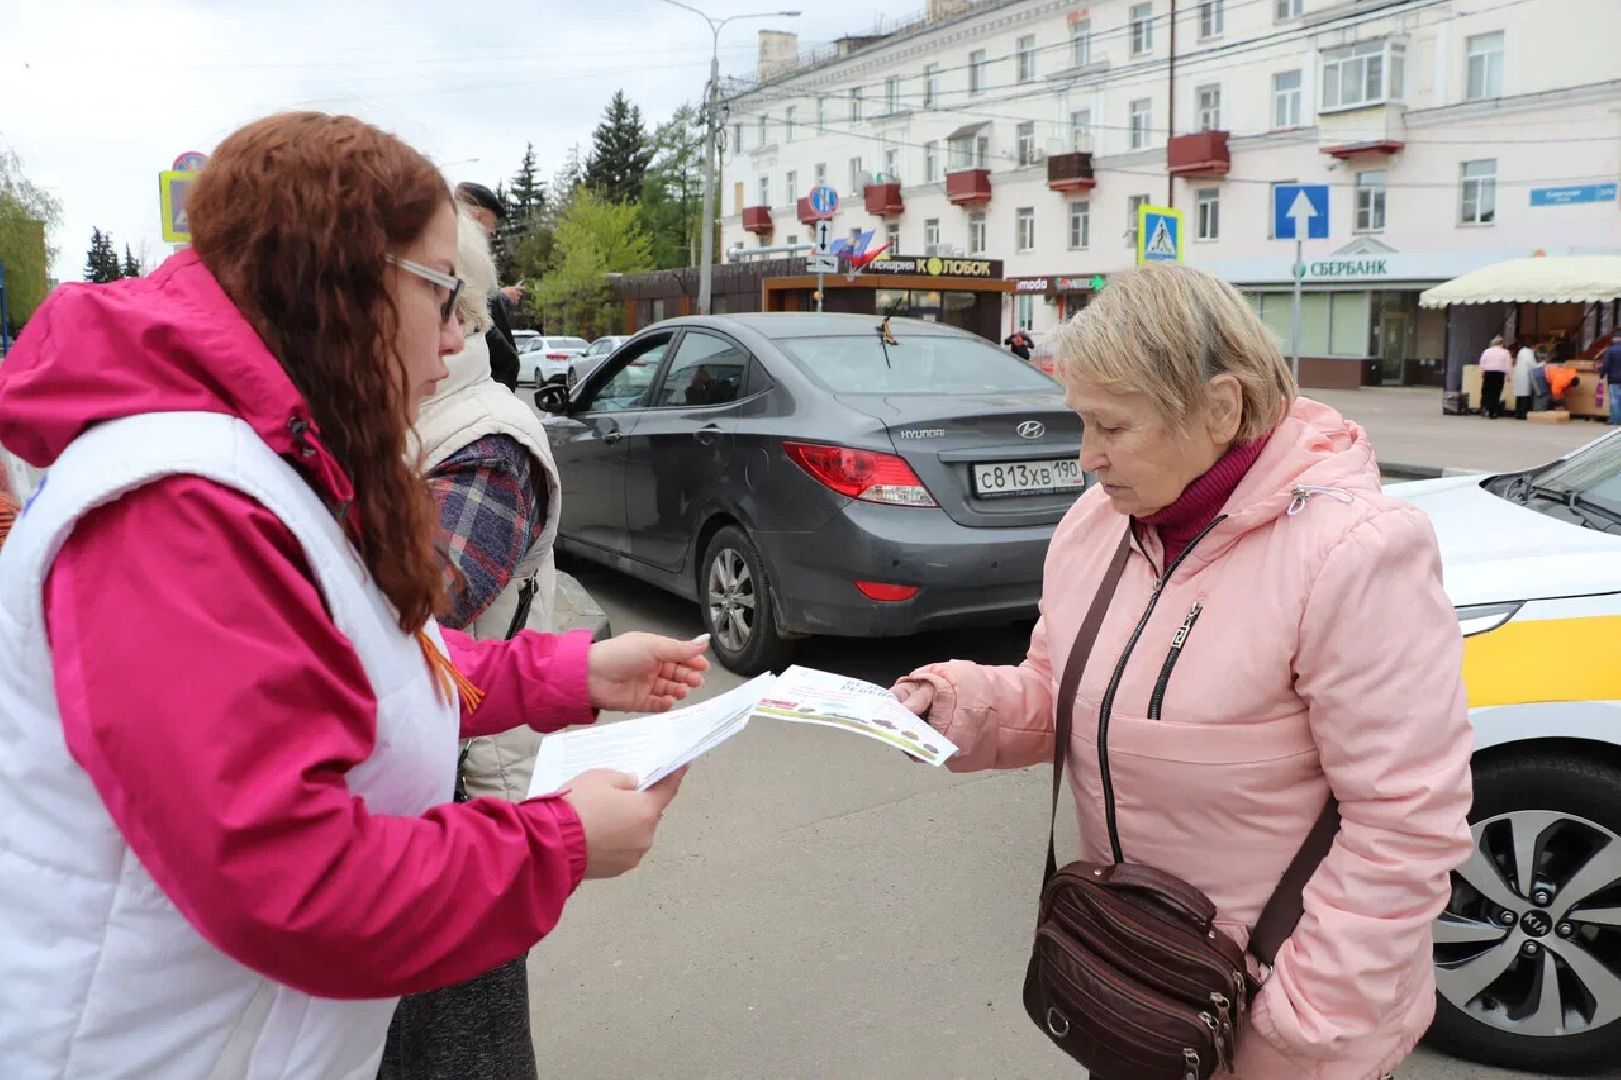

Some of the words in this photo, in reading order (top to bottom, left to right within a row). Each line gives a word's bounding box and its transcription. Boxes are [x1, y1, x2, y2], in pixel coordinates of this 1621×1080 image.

[916, 257, 990, 276] КОЛОБОК
[1310, 260, 1387, 275] СБЕРБАНК
[900, 429, 944, 439] HYUNDAI
[1523, 912, 1547, 935] KIA
